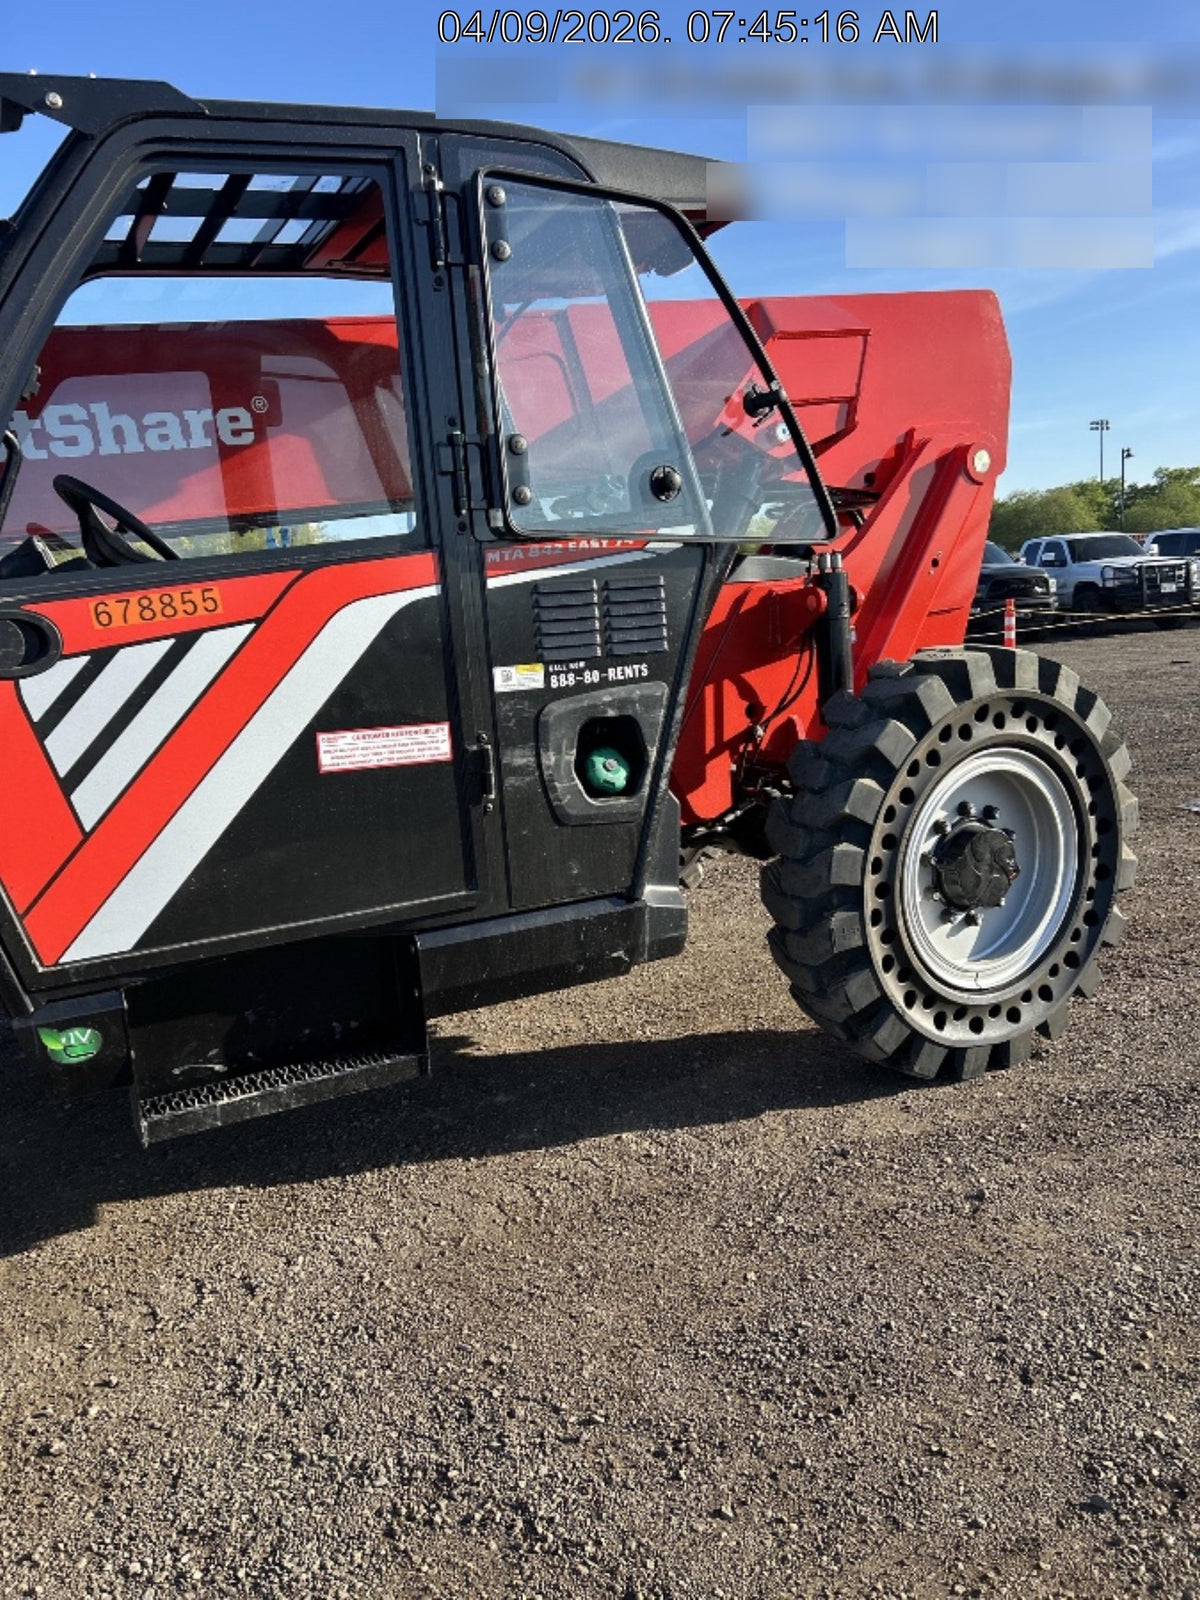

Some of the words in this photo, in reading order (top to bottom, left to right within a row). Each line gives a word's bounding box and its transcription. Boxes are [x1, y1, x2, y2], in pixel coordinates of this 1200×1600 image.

[487, 551, 524, 563] MTA
[528, 545, 563, 558] 842
[94, 588, 218, 627] 678855
[550, 663, 649, 688] 888-80-RENTS
